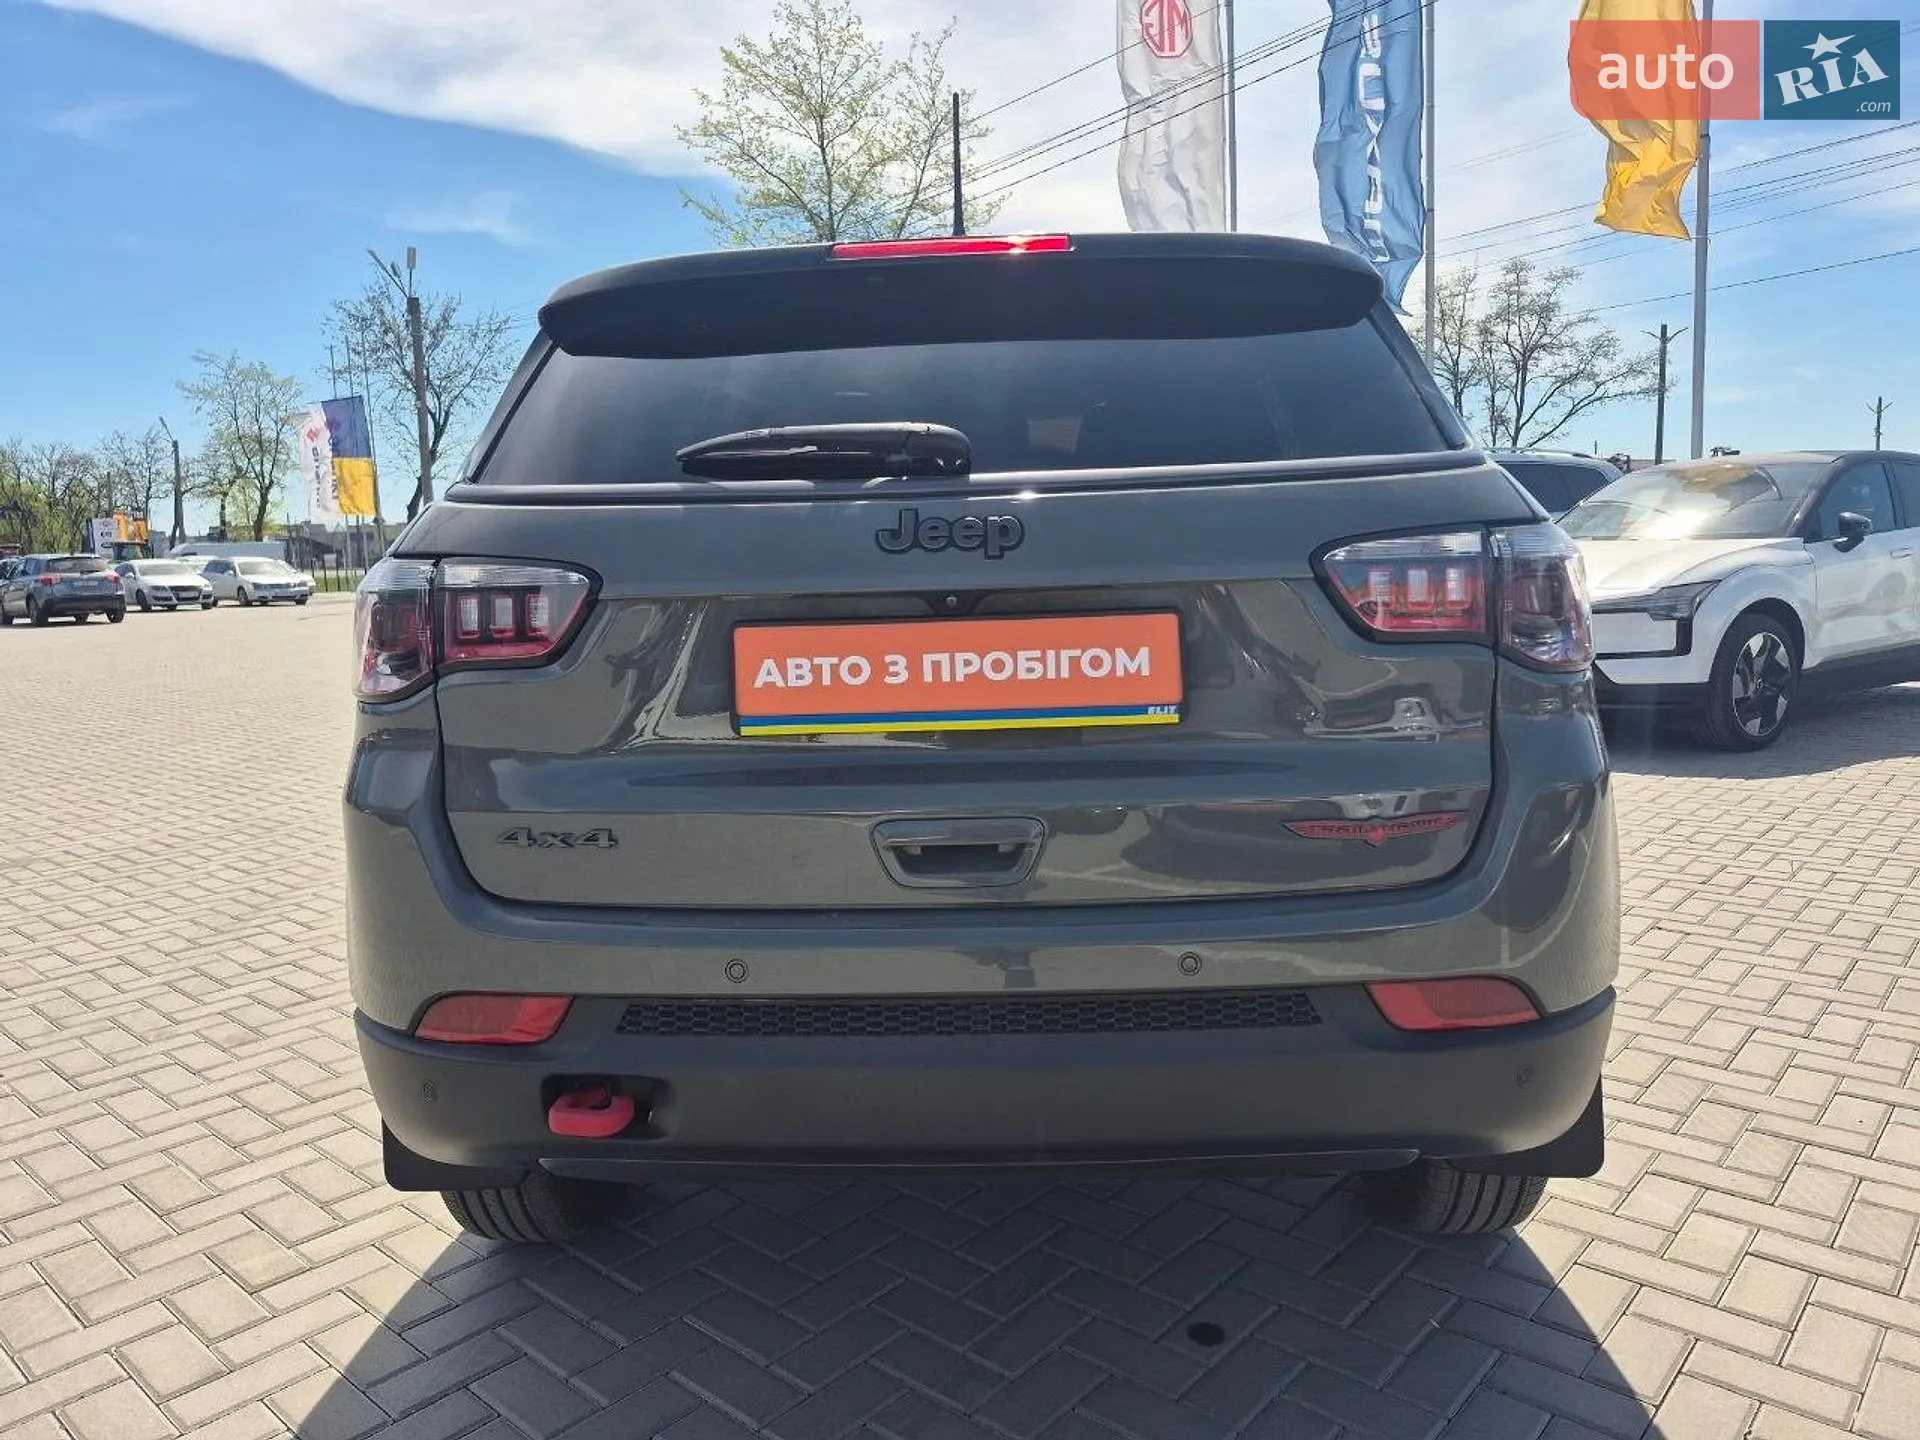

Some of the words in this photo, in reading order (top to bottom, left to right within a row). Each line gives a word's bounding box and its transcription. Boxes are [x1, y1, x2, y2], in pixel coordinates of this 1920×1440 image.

[875, 507, 1025, 559] Jeep
[753, 655, 872, 689] АВТО
[922, 646, 1151, 683] ПРОБІГОМ
[496, 826, 619, 849] 4x4
